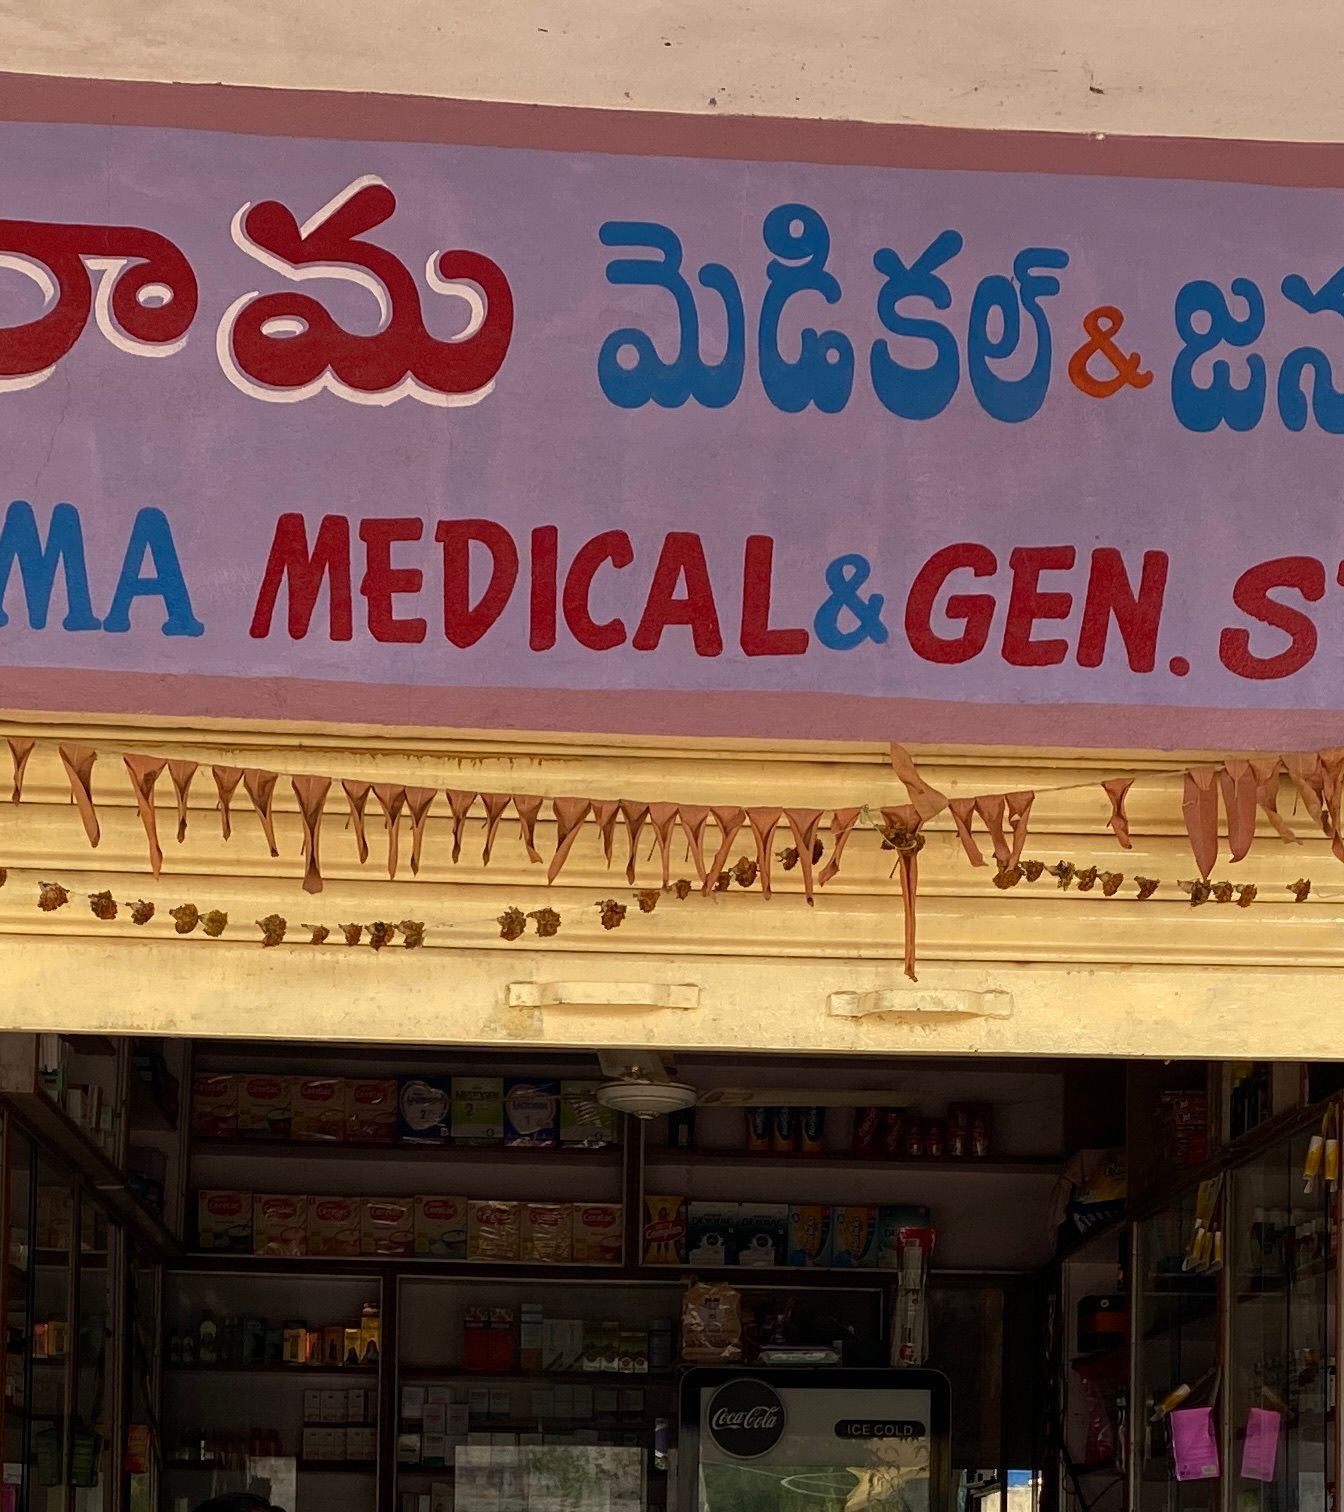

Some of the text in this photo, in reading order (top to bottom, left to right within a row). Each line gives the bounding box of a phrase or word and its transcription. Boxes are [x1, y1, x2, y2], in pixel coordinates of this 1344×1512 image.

[597, 203, 1069, 422] మెడికల్
[249, 512, 808, 658] MEDICAL
[903, 541, 1190, 676] GEN.
[846, 1423, 914, 1437] ICE COLD
